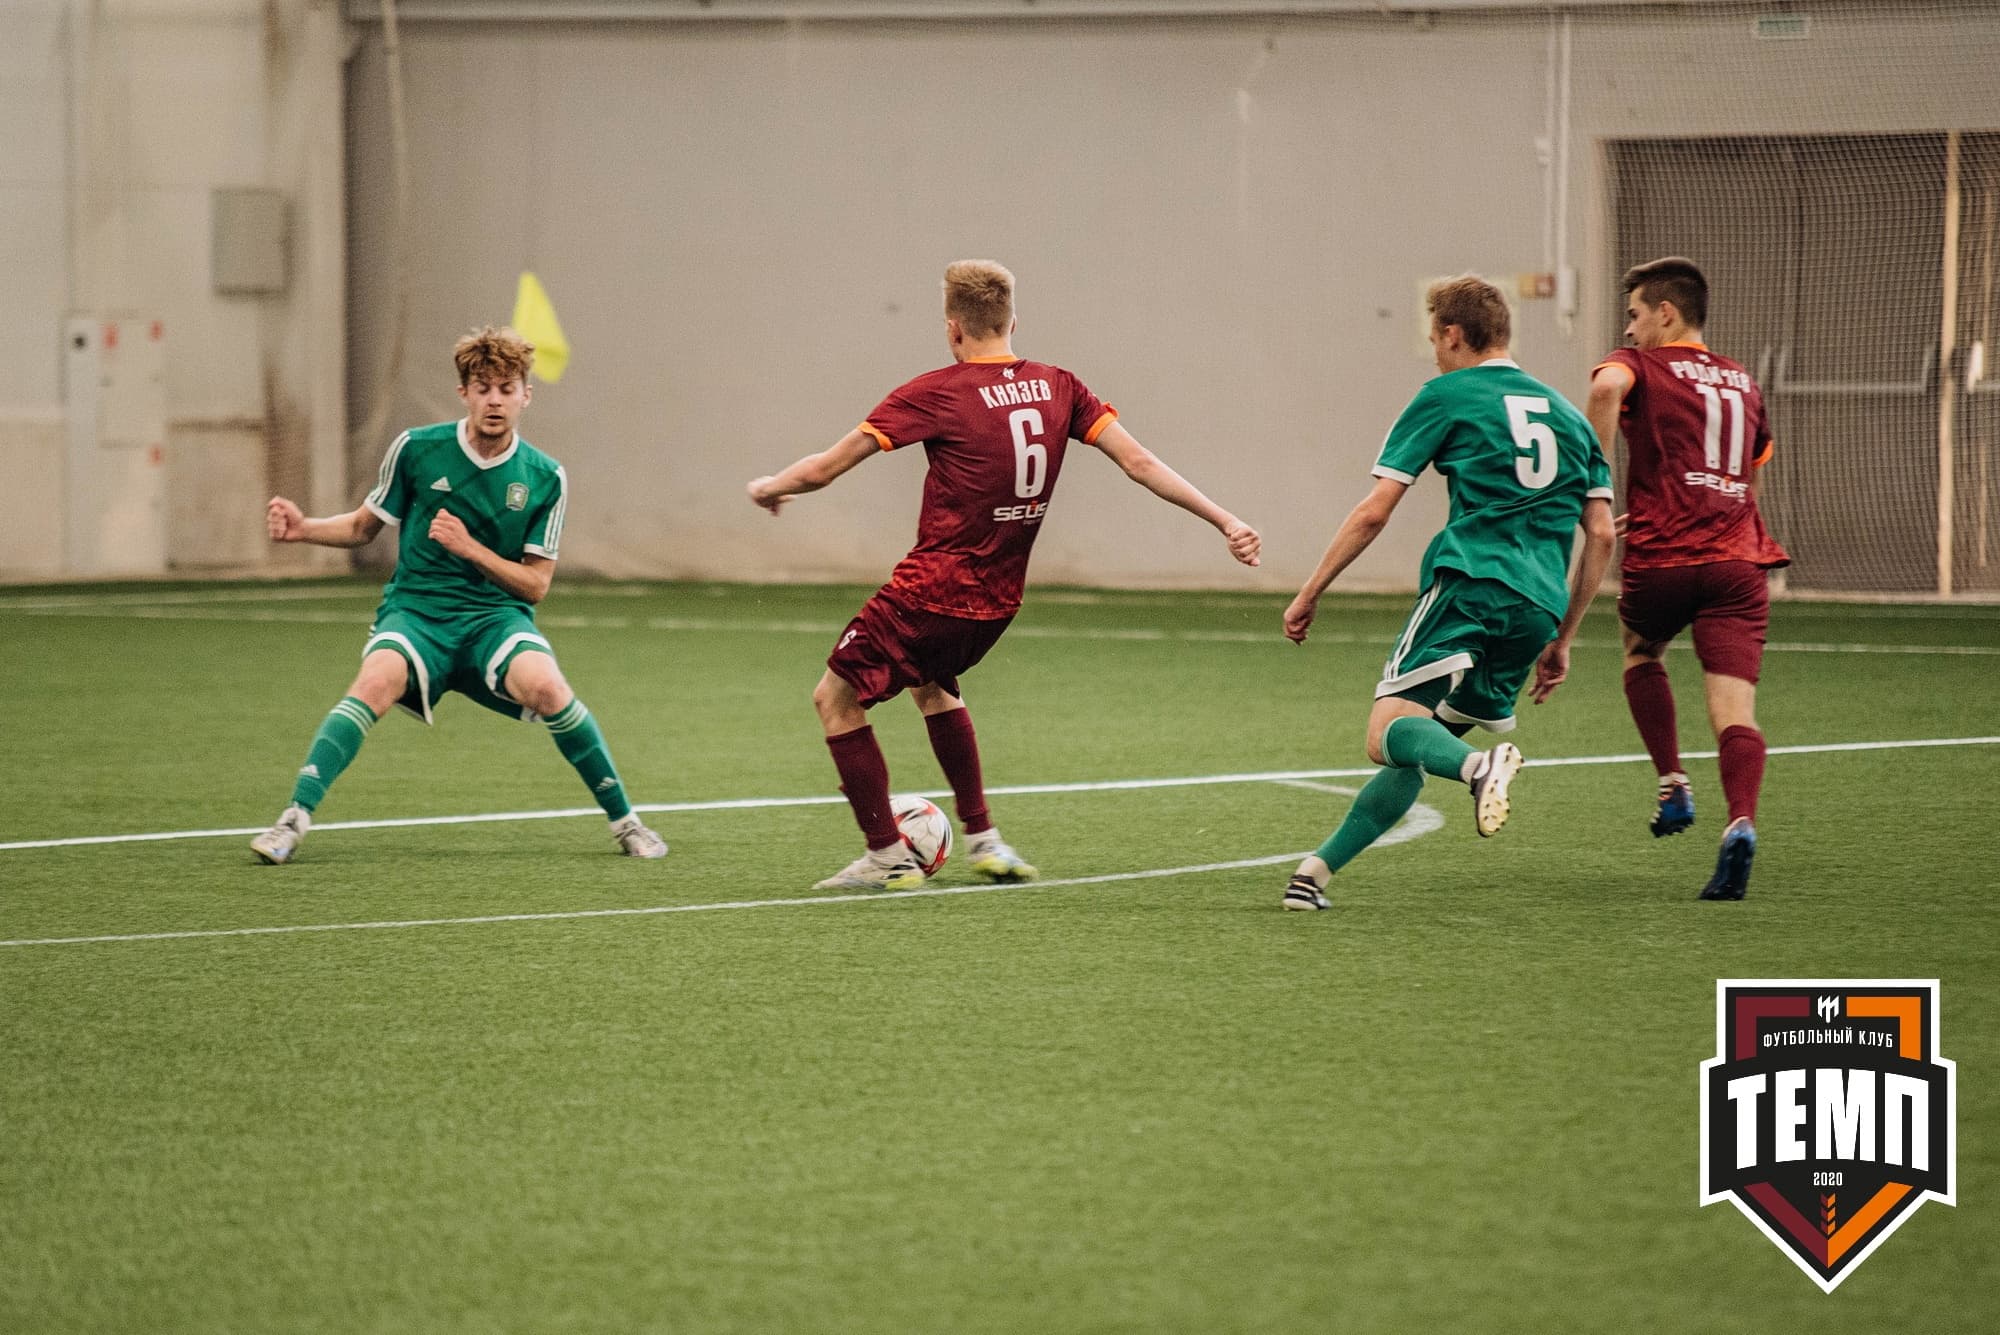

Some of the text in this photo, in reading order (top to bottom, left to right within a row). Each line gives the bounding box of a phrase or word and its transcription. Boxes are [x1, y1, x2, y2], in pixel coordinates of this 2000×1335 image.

[978, 379, 1052, 409] КНЯЗЕВ
[1694, 383, 1745, 476] 11
[1008, 408, 1048, 499] 6
[1503, 395, 1558, 489] 5
[992, 501, 1048, 522] SEUS
